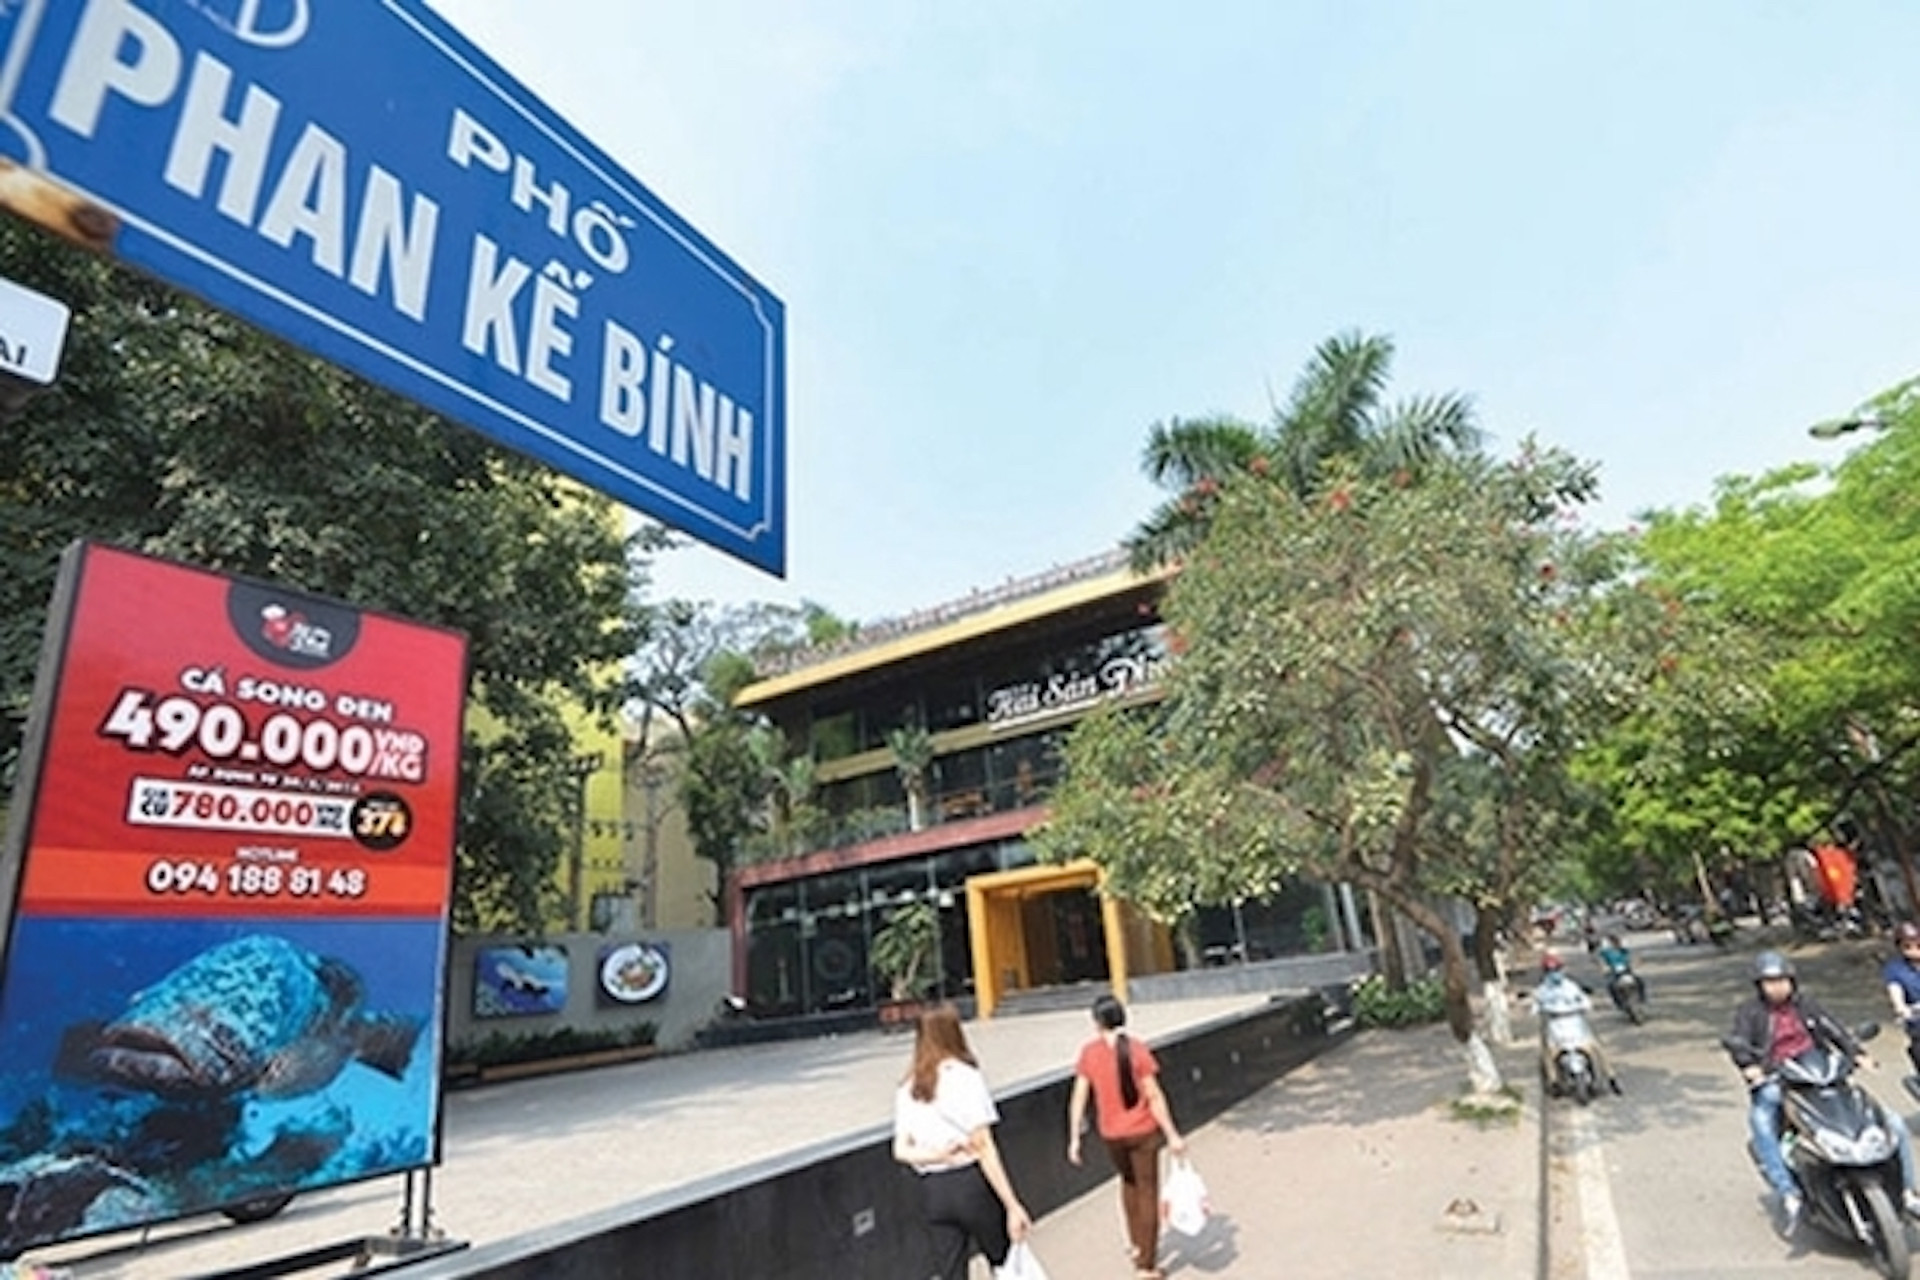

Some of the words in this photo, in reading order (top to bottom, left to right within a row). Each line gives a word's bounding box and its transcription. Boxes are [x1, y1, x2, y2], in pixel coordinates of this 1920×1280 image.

[448, 108, 637, 273] PHỐ
[49, 0, 439, 322] PHAN
[462, 234, 593, 402] KẾ
[601, 320, 753, 502] BÍNH
[104, 690, 372, 772] 490.000
[171, 790, 314, 825] 780.000
[149, 859, 219, 893] 094
[228, 864, 283, 895] 188
[289, 867, 321, 895] 81
[328, 868, 366, 896] 48
